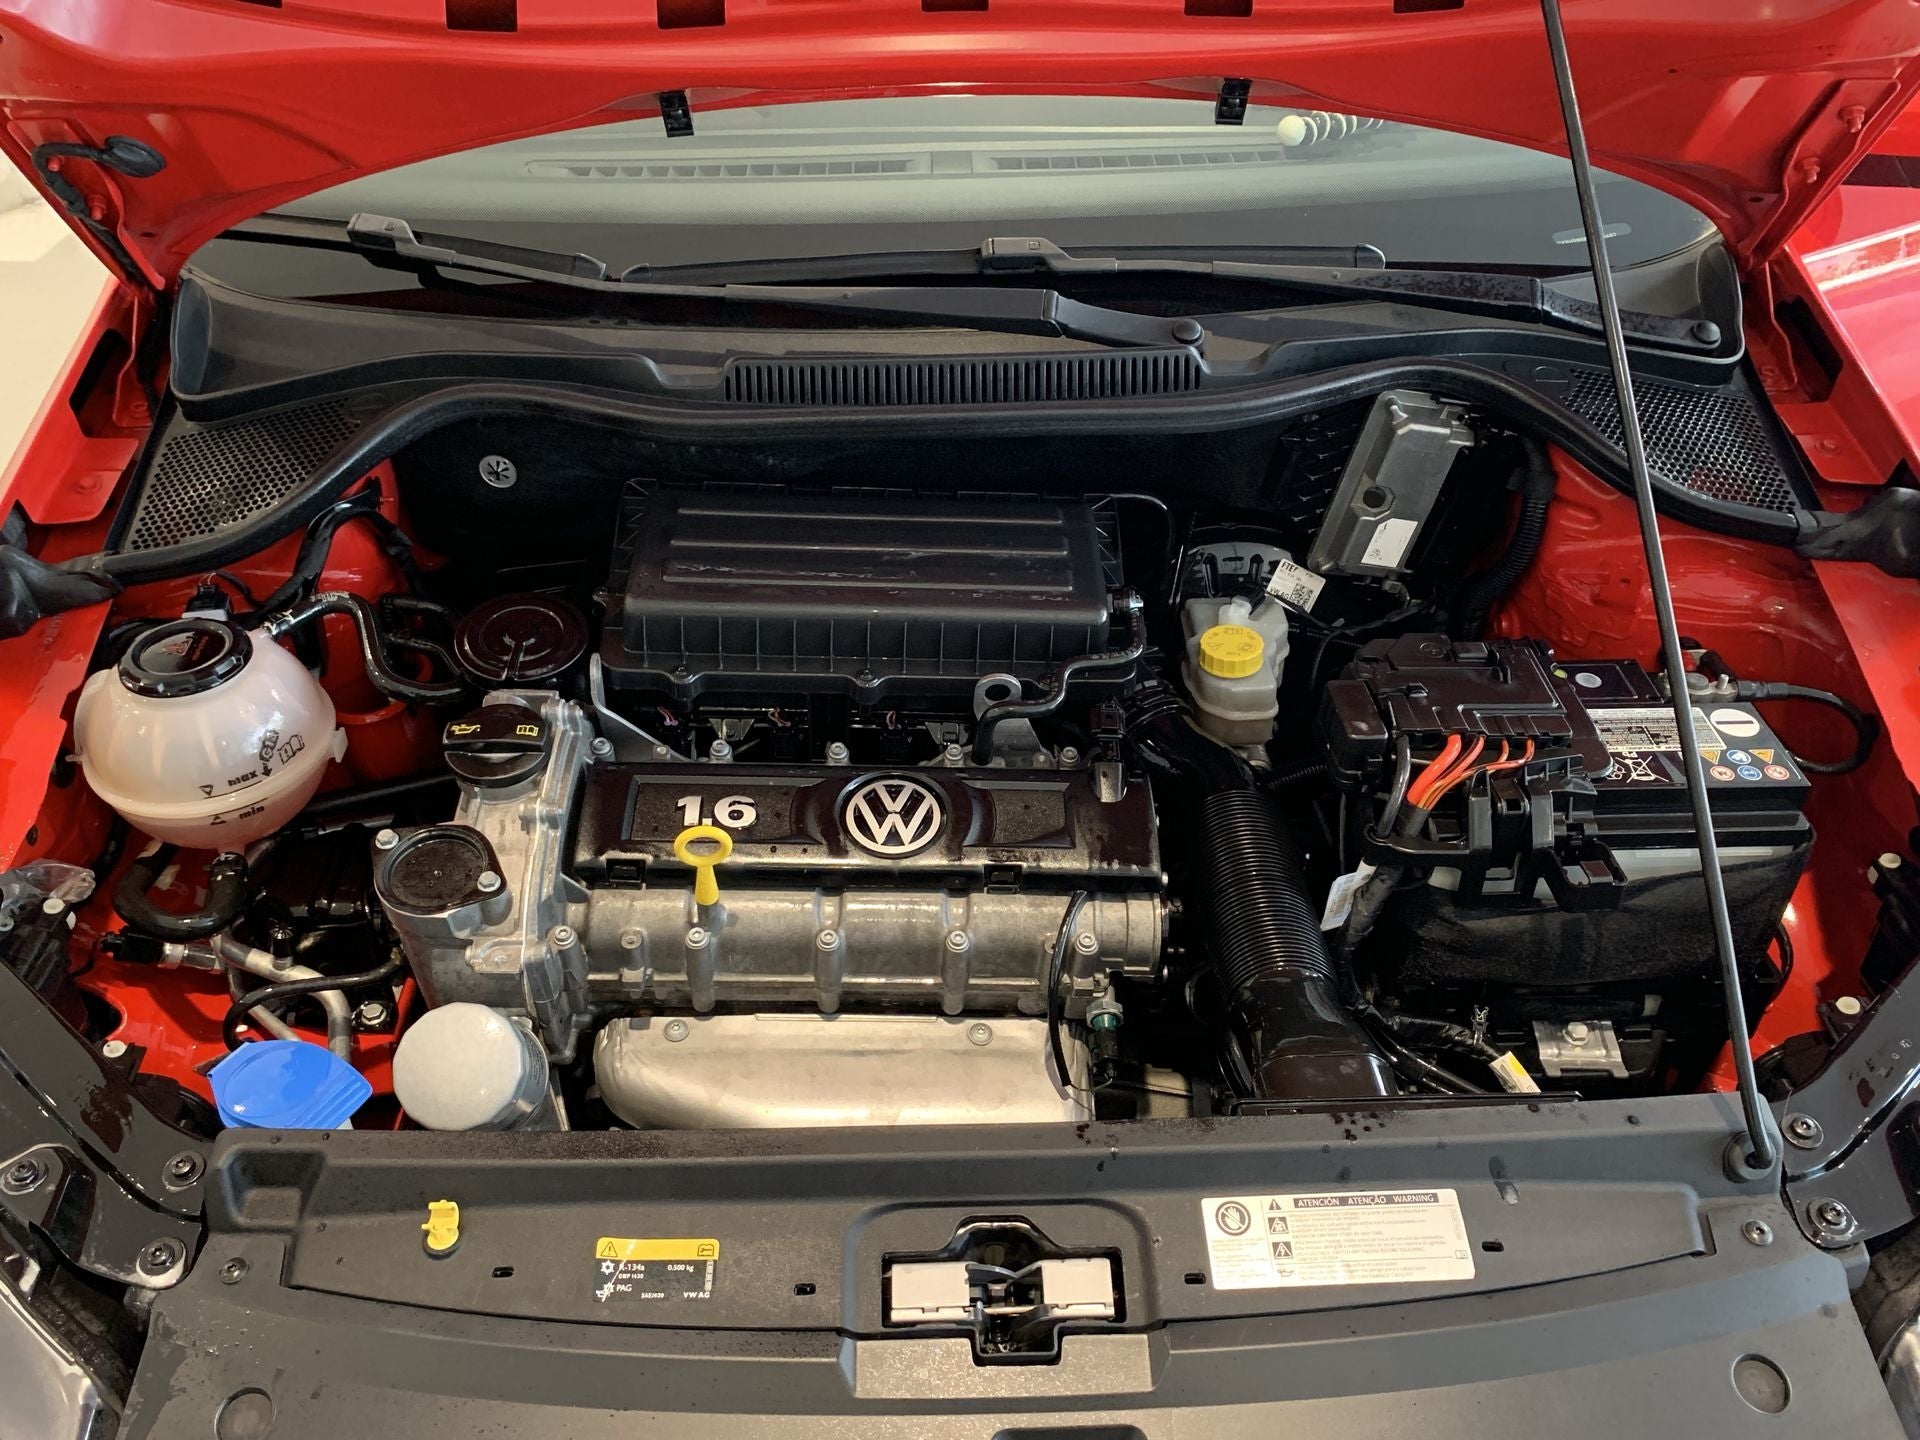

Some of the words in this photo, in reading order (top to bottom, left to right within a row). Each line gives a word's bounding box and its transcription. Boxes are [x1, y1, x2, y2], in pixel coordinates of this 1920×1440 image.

[227, 770, 258, 786] max
[238, 805, 265, 820] min
[676, 795, 757, 828] 1.6
[1298, 1196, 1340, 1207] ATENCIÓN
[1347, 1193, 1387, 1205] ATENÇÃO
[1392, 1193, 1434, 1203] WARNING
[686, 1264, 695, 1273] kg
[616, 1284, 632, 1292] PAG
